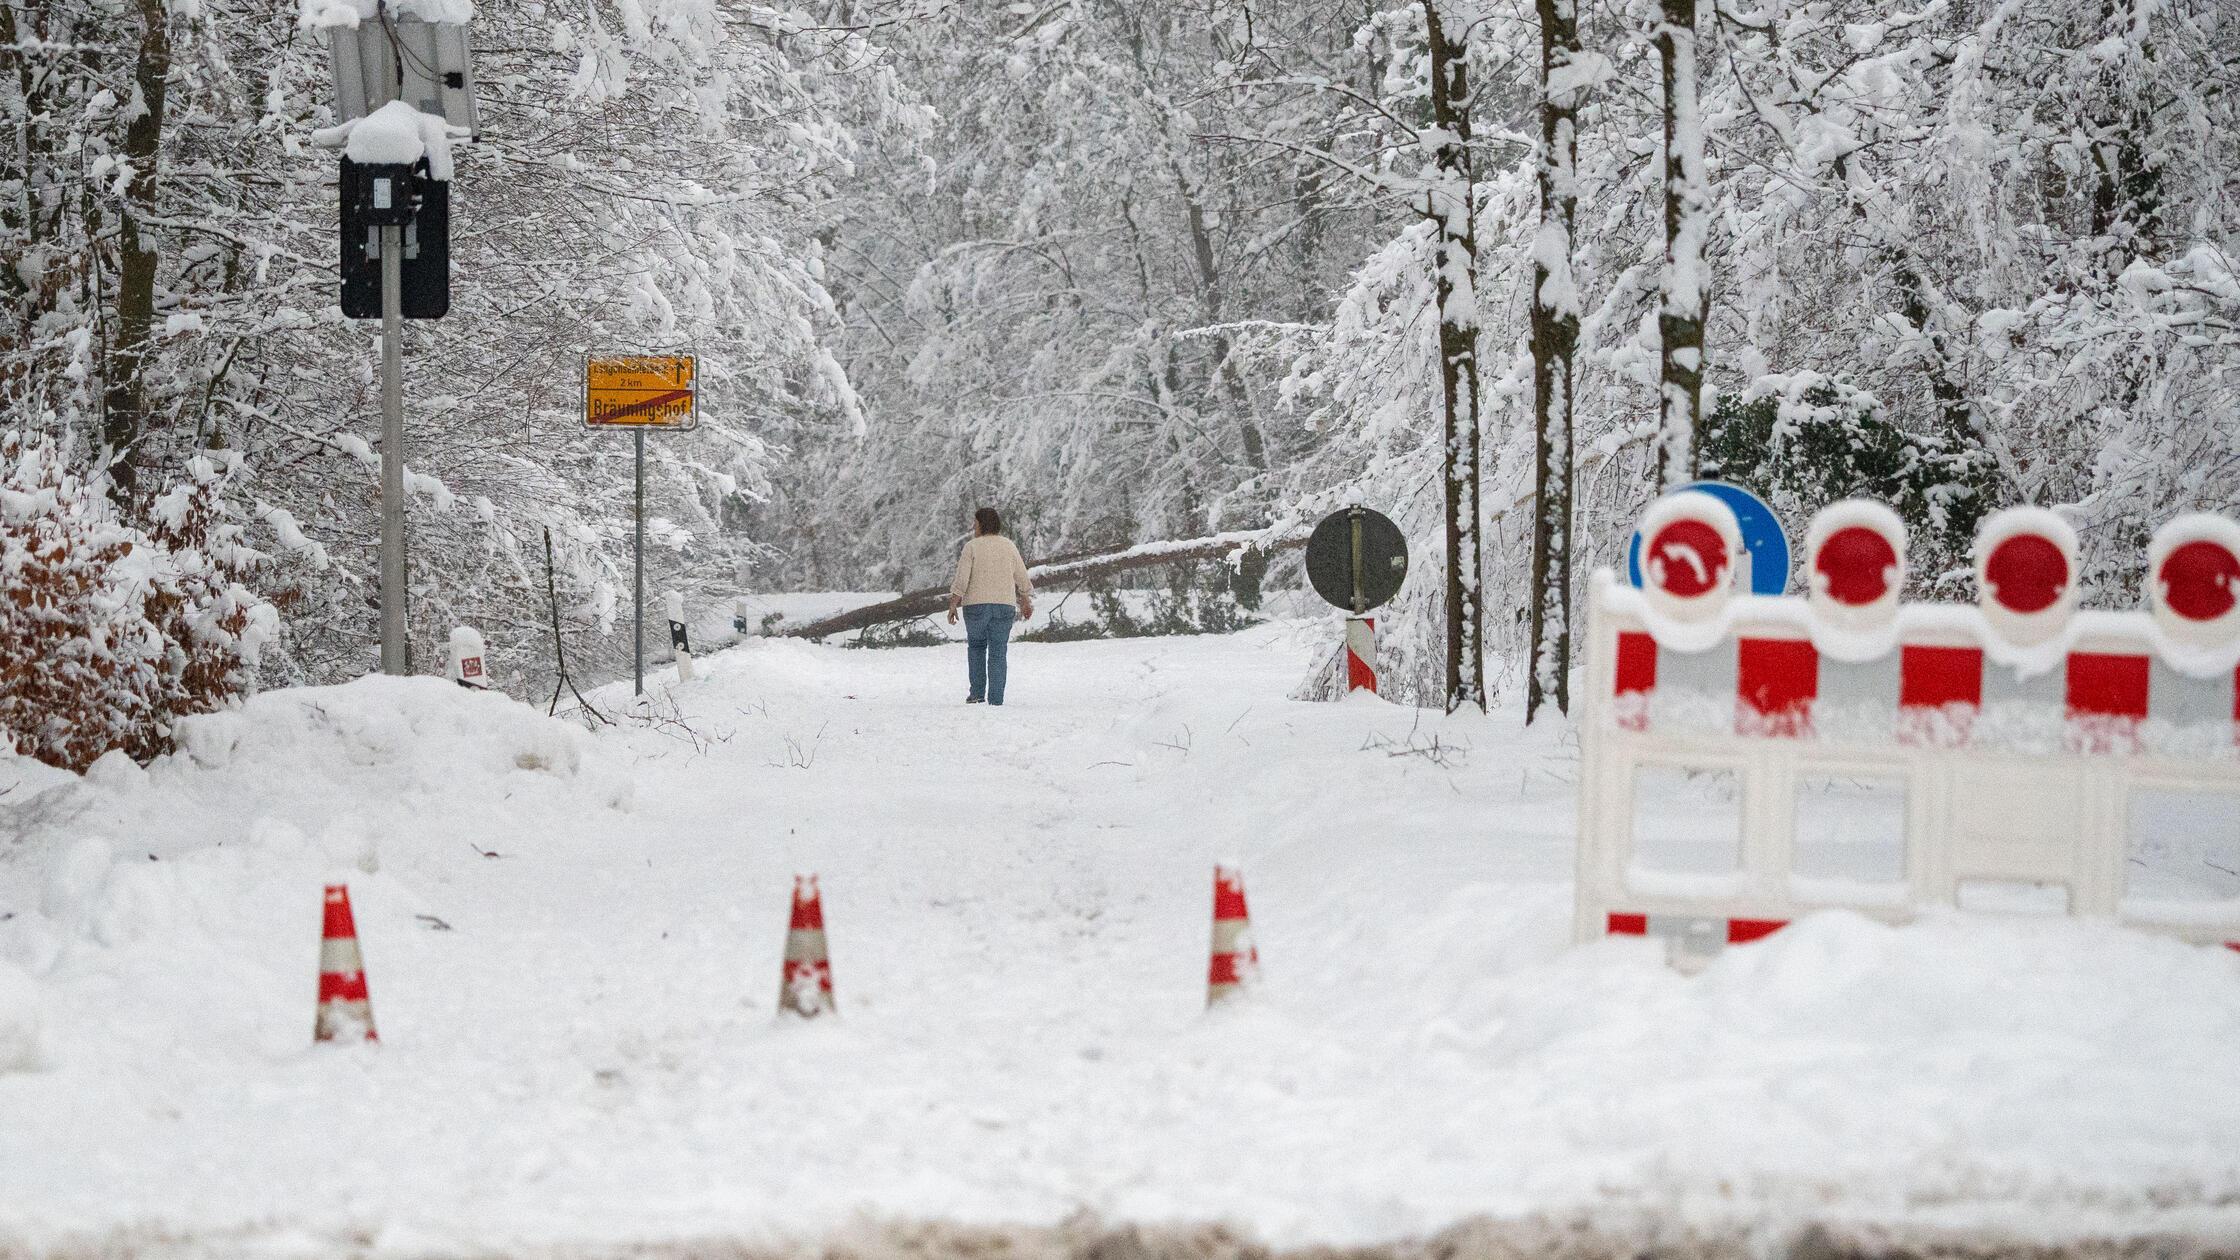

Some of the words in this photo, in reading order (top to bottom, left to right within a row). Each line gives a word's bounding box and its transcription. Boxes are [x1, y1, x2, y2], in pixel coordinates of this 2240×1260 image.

[620, 378, 626, 387] 2
[627, 378, 642, 387] km
[594, 399, 687, 421] Bräuningshof
